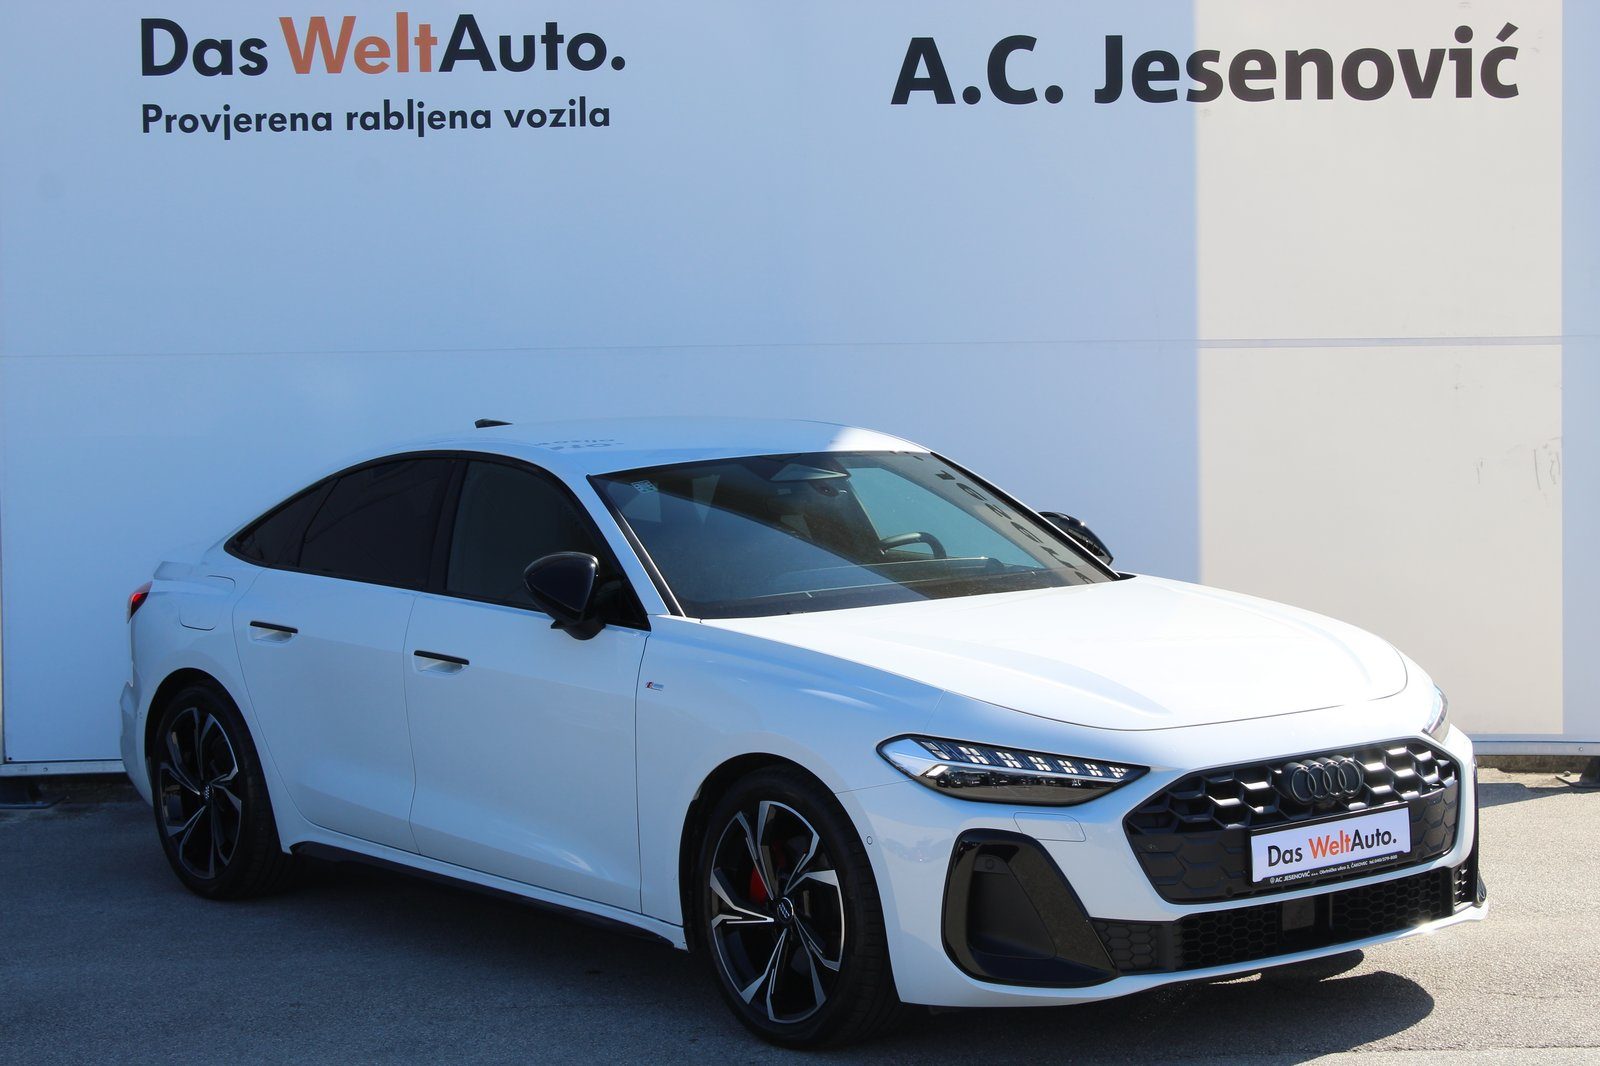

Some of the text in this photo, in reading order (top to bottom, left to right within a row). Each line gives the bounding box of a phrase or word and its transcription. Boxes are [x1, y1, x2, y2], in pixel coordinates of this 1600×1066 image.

[141, 12, 626, 77] Das WeltAuto.
[891, 22, 1519, 105] A.C. Jesenović
[142, 95, 610, 141] Provjerena rabljena vozila
[1267, 828, 1397, 867] Das WeltAuto.
